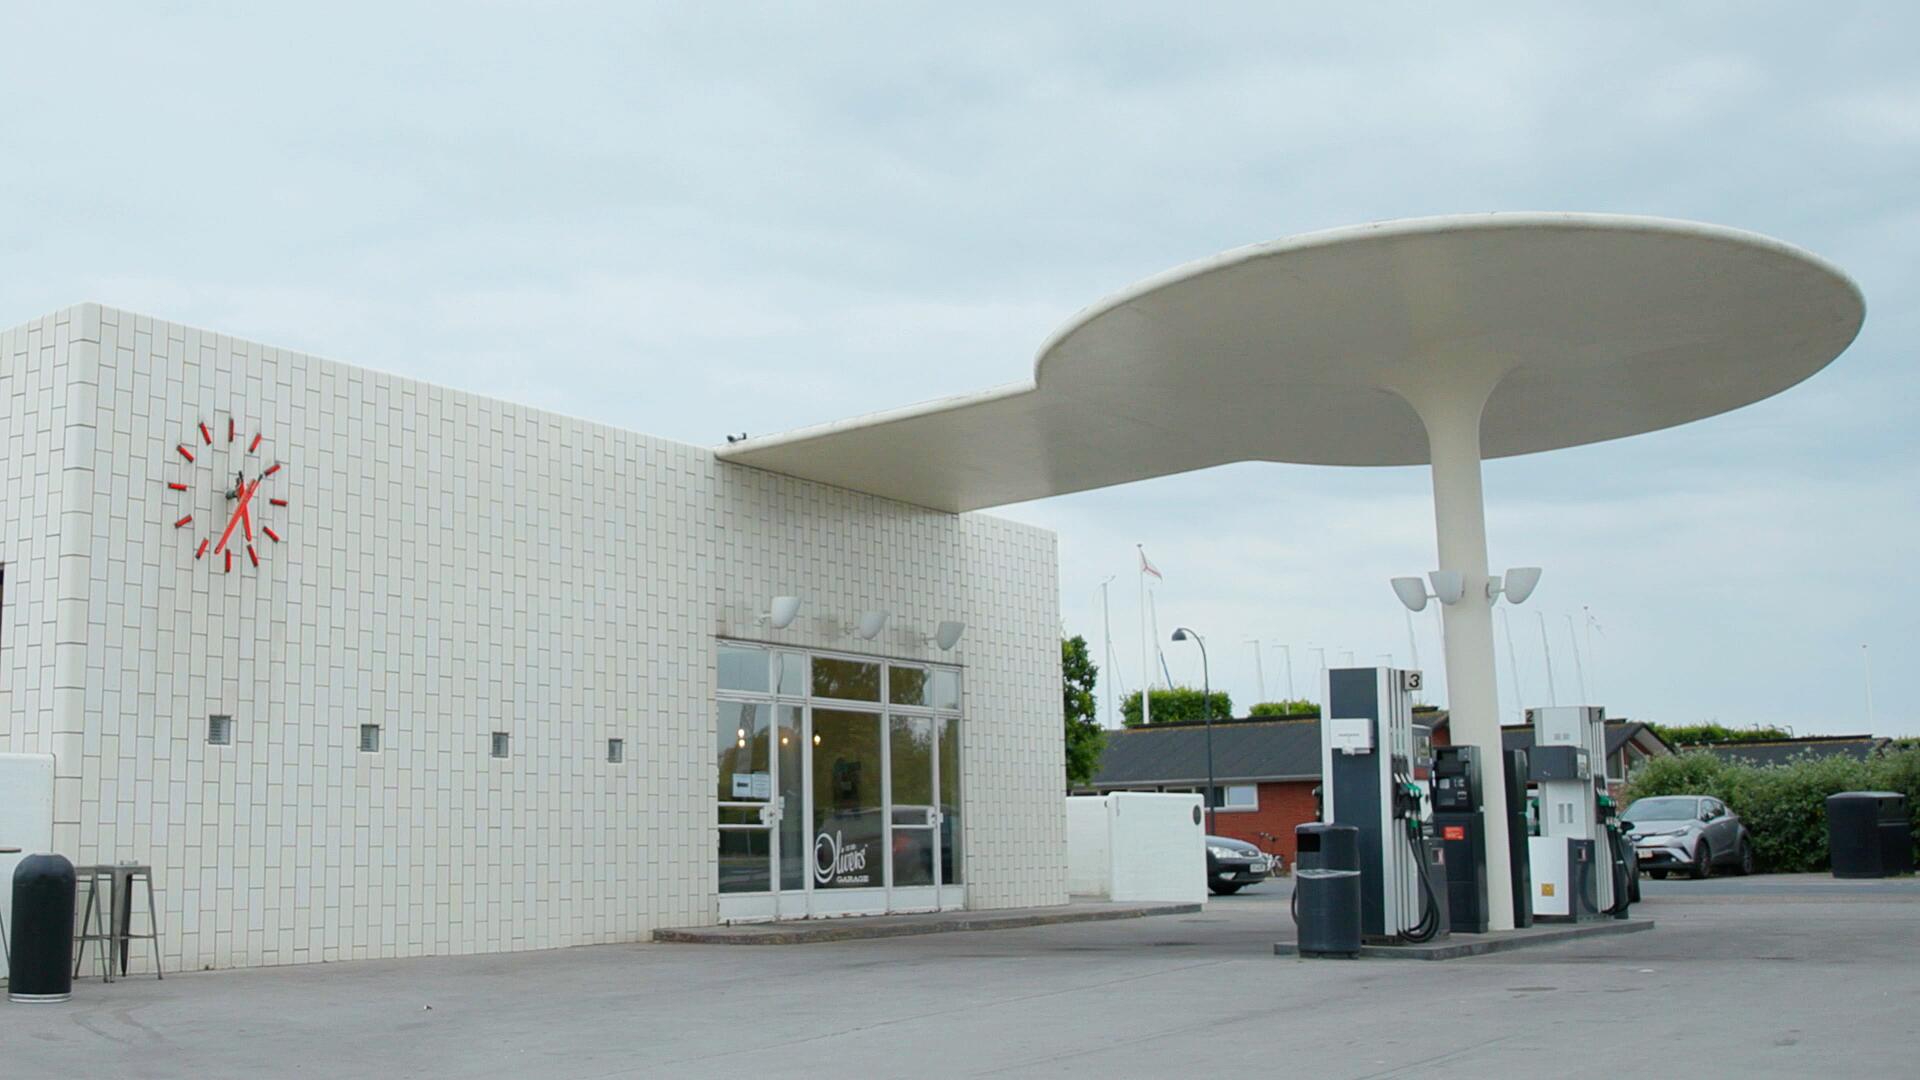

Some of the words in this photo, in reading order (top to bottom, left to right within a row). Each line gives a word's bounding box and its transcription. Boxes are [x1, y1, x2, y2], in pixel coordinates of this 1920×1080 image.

[1409, 673, 1420, 688] 3
[1526, 711, 1534, 722] 2
[836, 875, 869, 883] GARAGE
